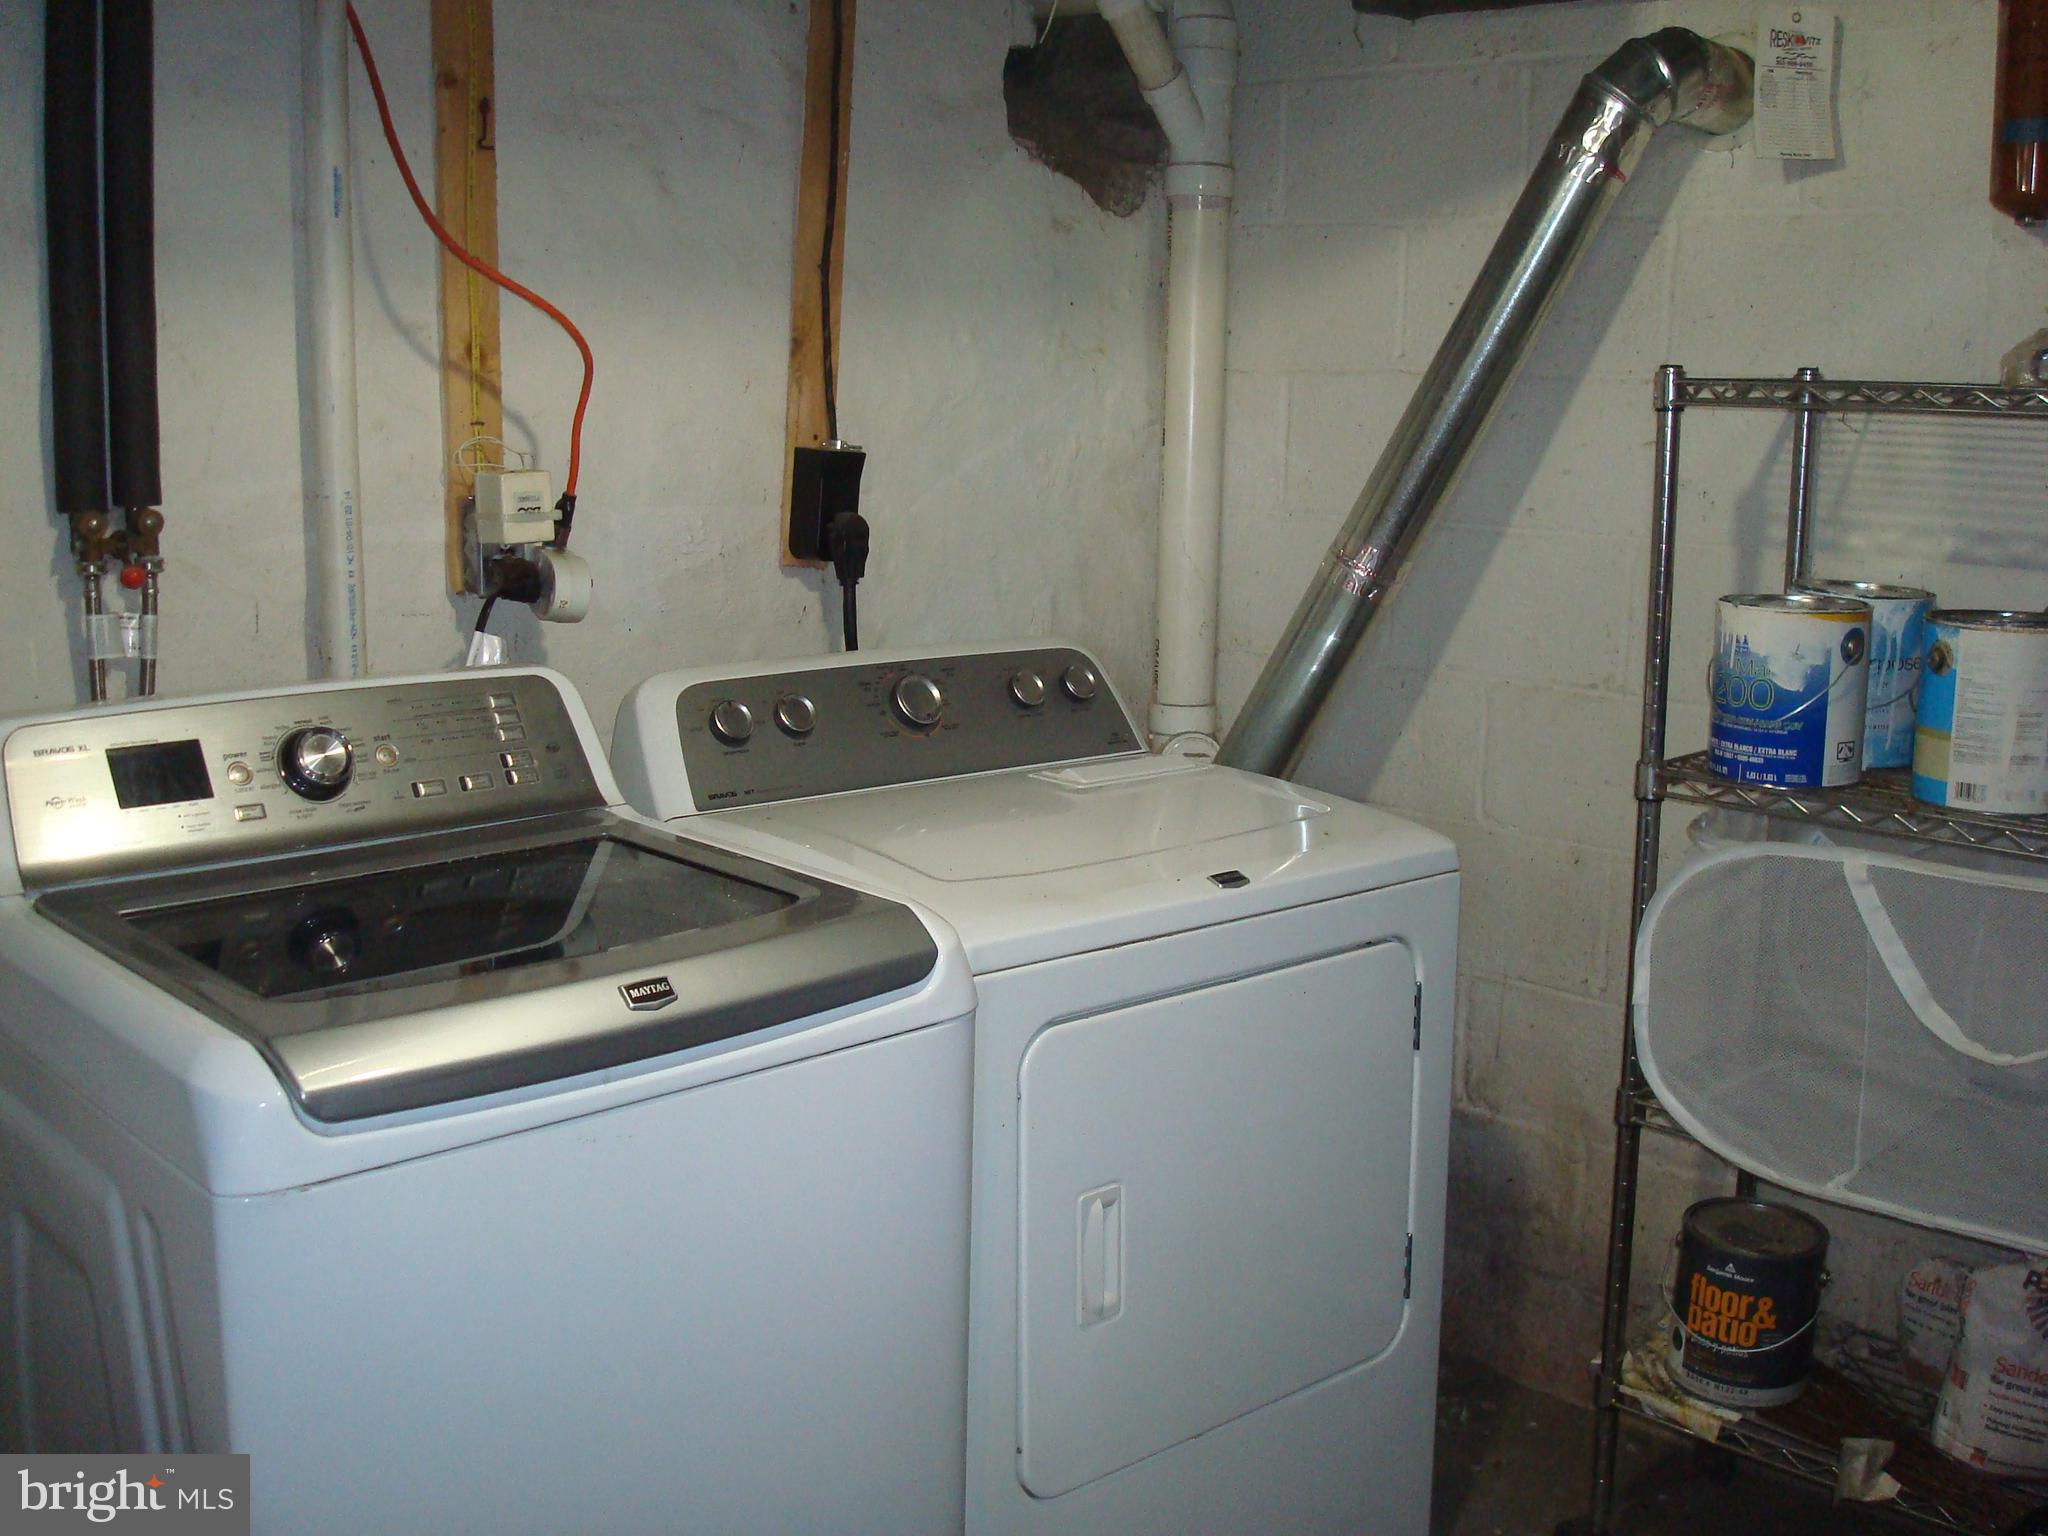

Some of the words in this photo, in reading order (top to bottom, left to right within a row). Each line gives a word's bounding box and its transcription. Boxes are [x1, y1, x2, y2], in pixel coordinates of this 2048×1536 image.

[222, 751, 248, 762] power
[629, 981, 670, 998] MAYTAG
[1690, 1271, 1756, 1320] floor
[1752, 1295, 1776, 1330] &
[1687, 1303, 1760, 1348] patio
